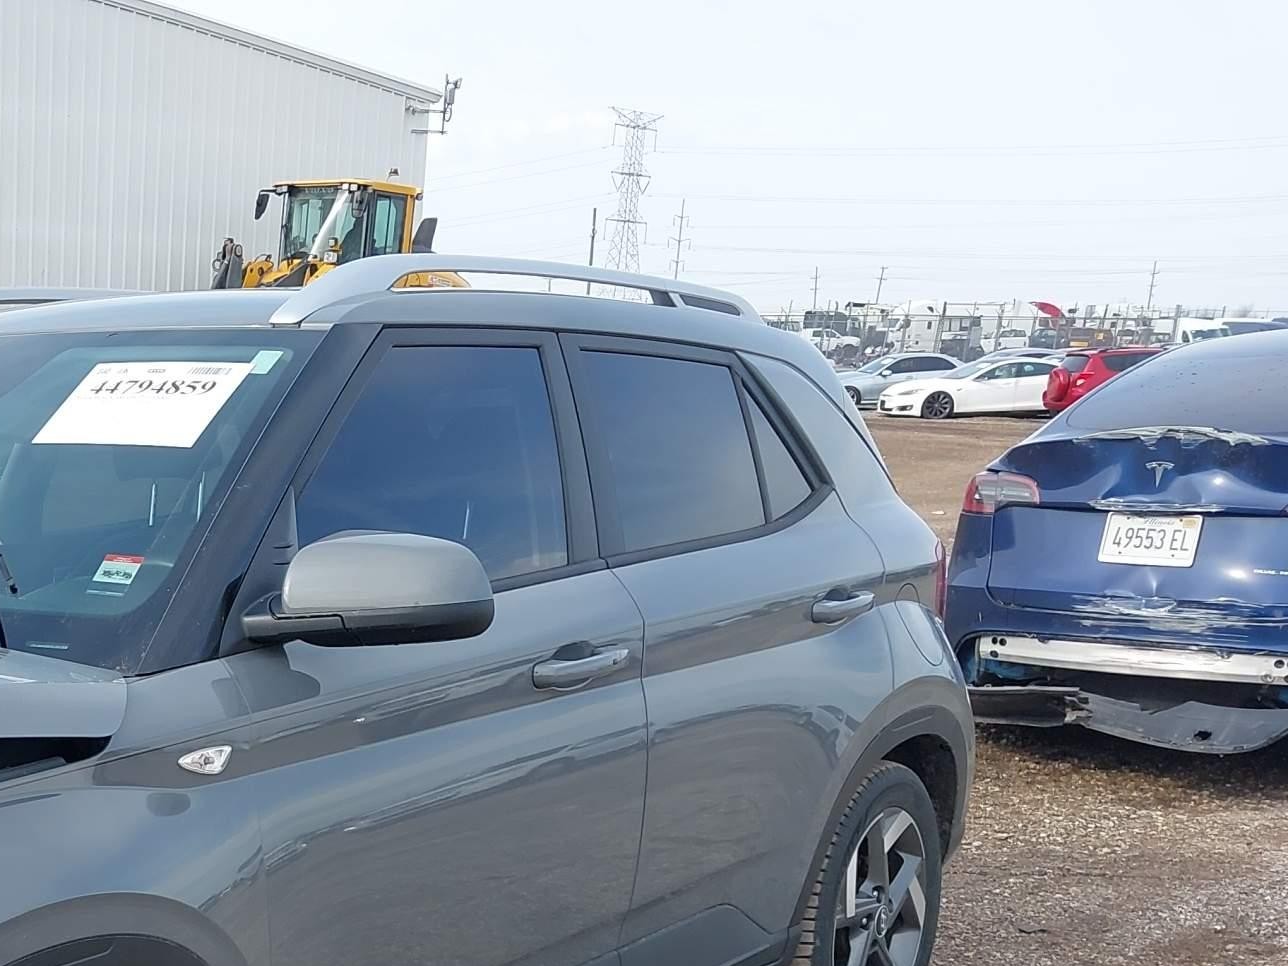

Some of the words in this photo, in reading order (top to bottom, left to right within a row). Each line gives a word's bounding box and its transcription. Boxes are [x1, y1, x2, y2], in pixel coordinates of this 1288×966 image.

[90, 379, 217, 395] 44794859
[1112, 526, 1167, 550] 49553
[1169, 529, 1190, 552] EL
